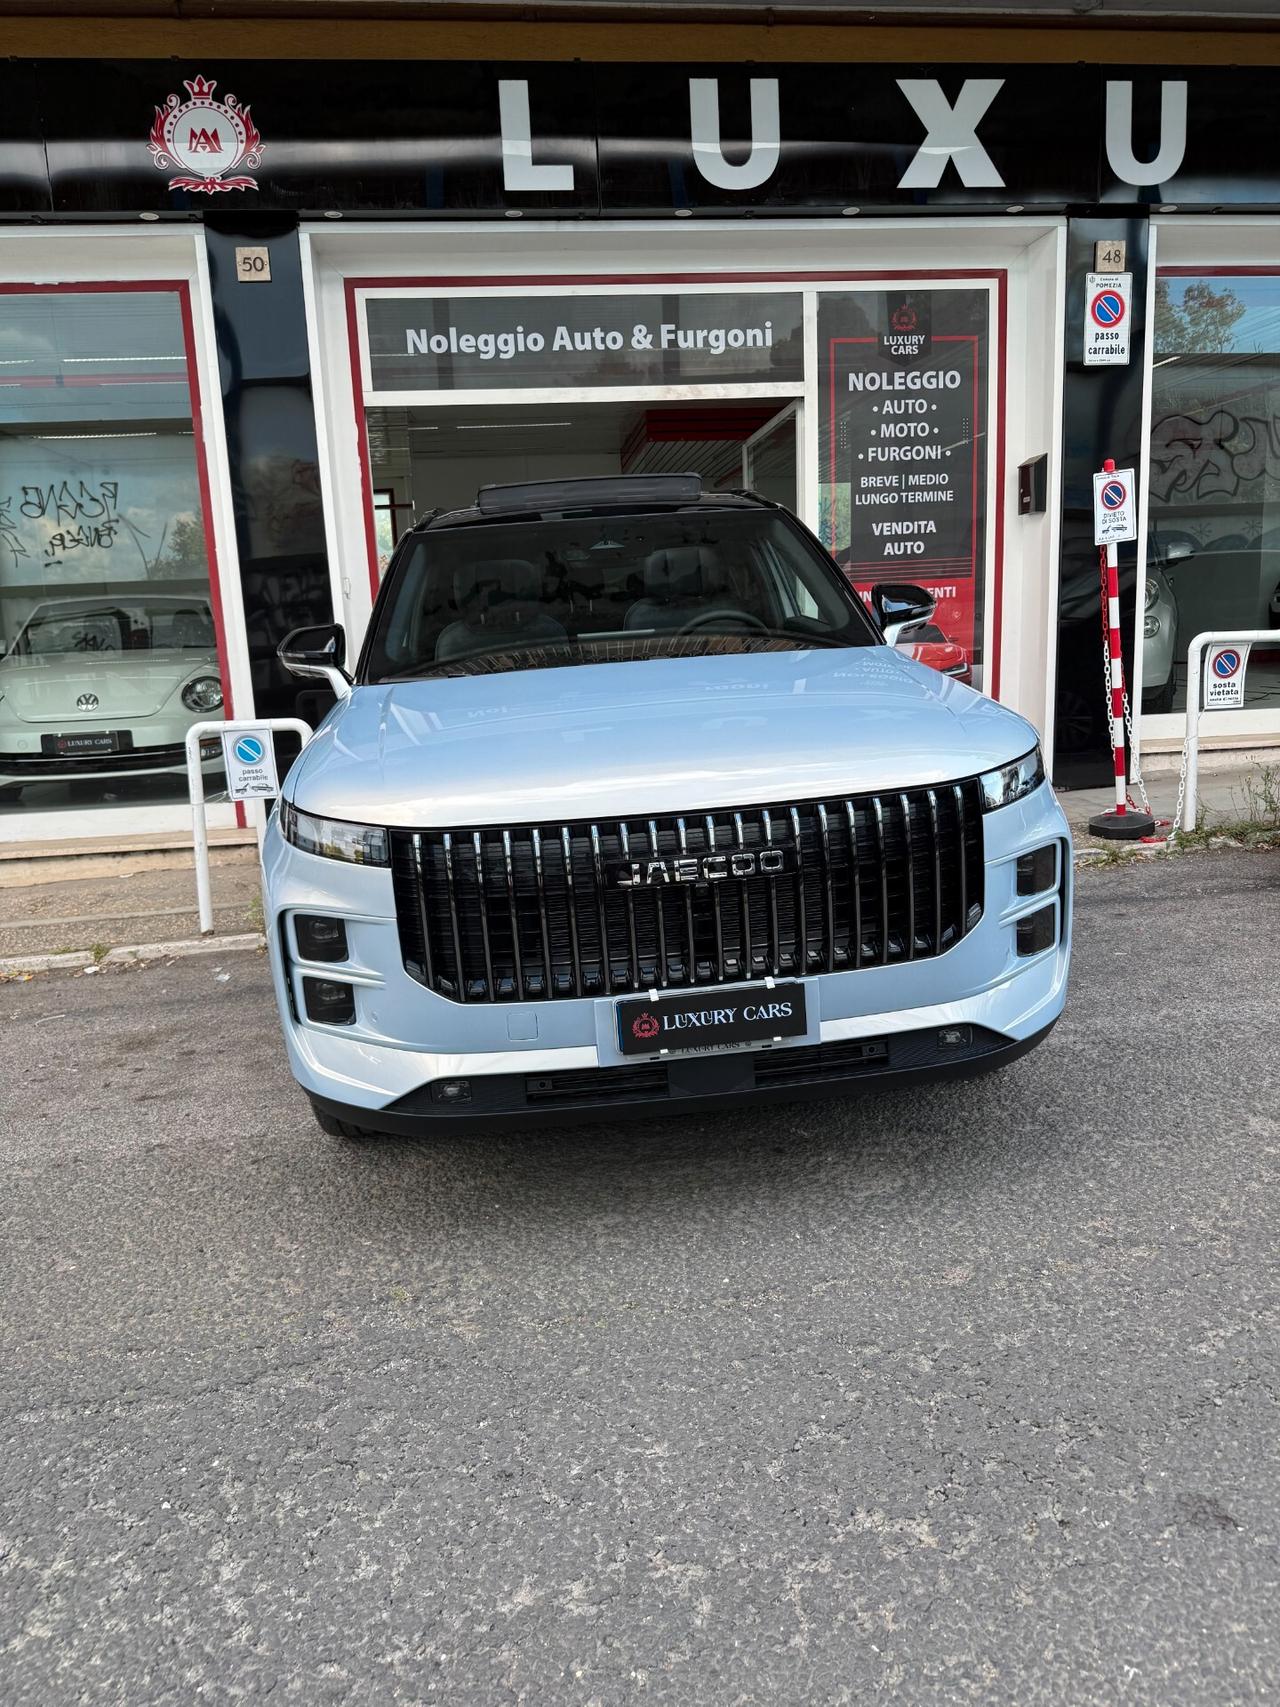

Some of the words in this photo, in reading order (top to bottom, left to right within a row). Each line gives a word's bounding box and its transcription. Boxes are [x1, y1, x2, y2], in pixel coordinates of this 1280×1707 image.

[498, 77, 1188, 190] LUXU
[1102, 249, 1121, 263] 48
[242, 256, 265, 272] 50
[405, 325, 545, 360] Noleggio
[552, 326, 624, 351] Auto
[630, 324, 654, 349] &
[660, 321, 773, 356] Furgoni
[884, 335, 926, 345] LUXURY
[1095, 331, 1119, 343] passo
[891, 345, 919, 355] CARS
[1088, 344, 1125, 355] carrabile
[848, 370, 961, 391] NOLEGGIO
[882, 399, 928, 415] AUTO
[880, 422, 930, 438] MOTO
[868, 445, 942, 462] FURGONI
[860, 475, 899, 488] BREVE
[908, 473, 949, 486] MEDIO
[855, 492, 899, 505] LUNGO
[900, 490, 954, 503] TERMINE
[1103, 511, 1125, 519] DIVIETO
[872, 520, 936, 536] VENDITA
[883, 541, 925, 555] AUTO
[1209, 688, 1239, 696] vietata
[67, 739, 93, 747] LUXURY
[617, 850, 784, 886] JAECOO
[662, 1007, 738, 1031] LUXURY
[743, 1002, 793, 1022] CARS
